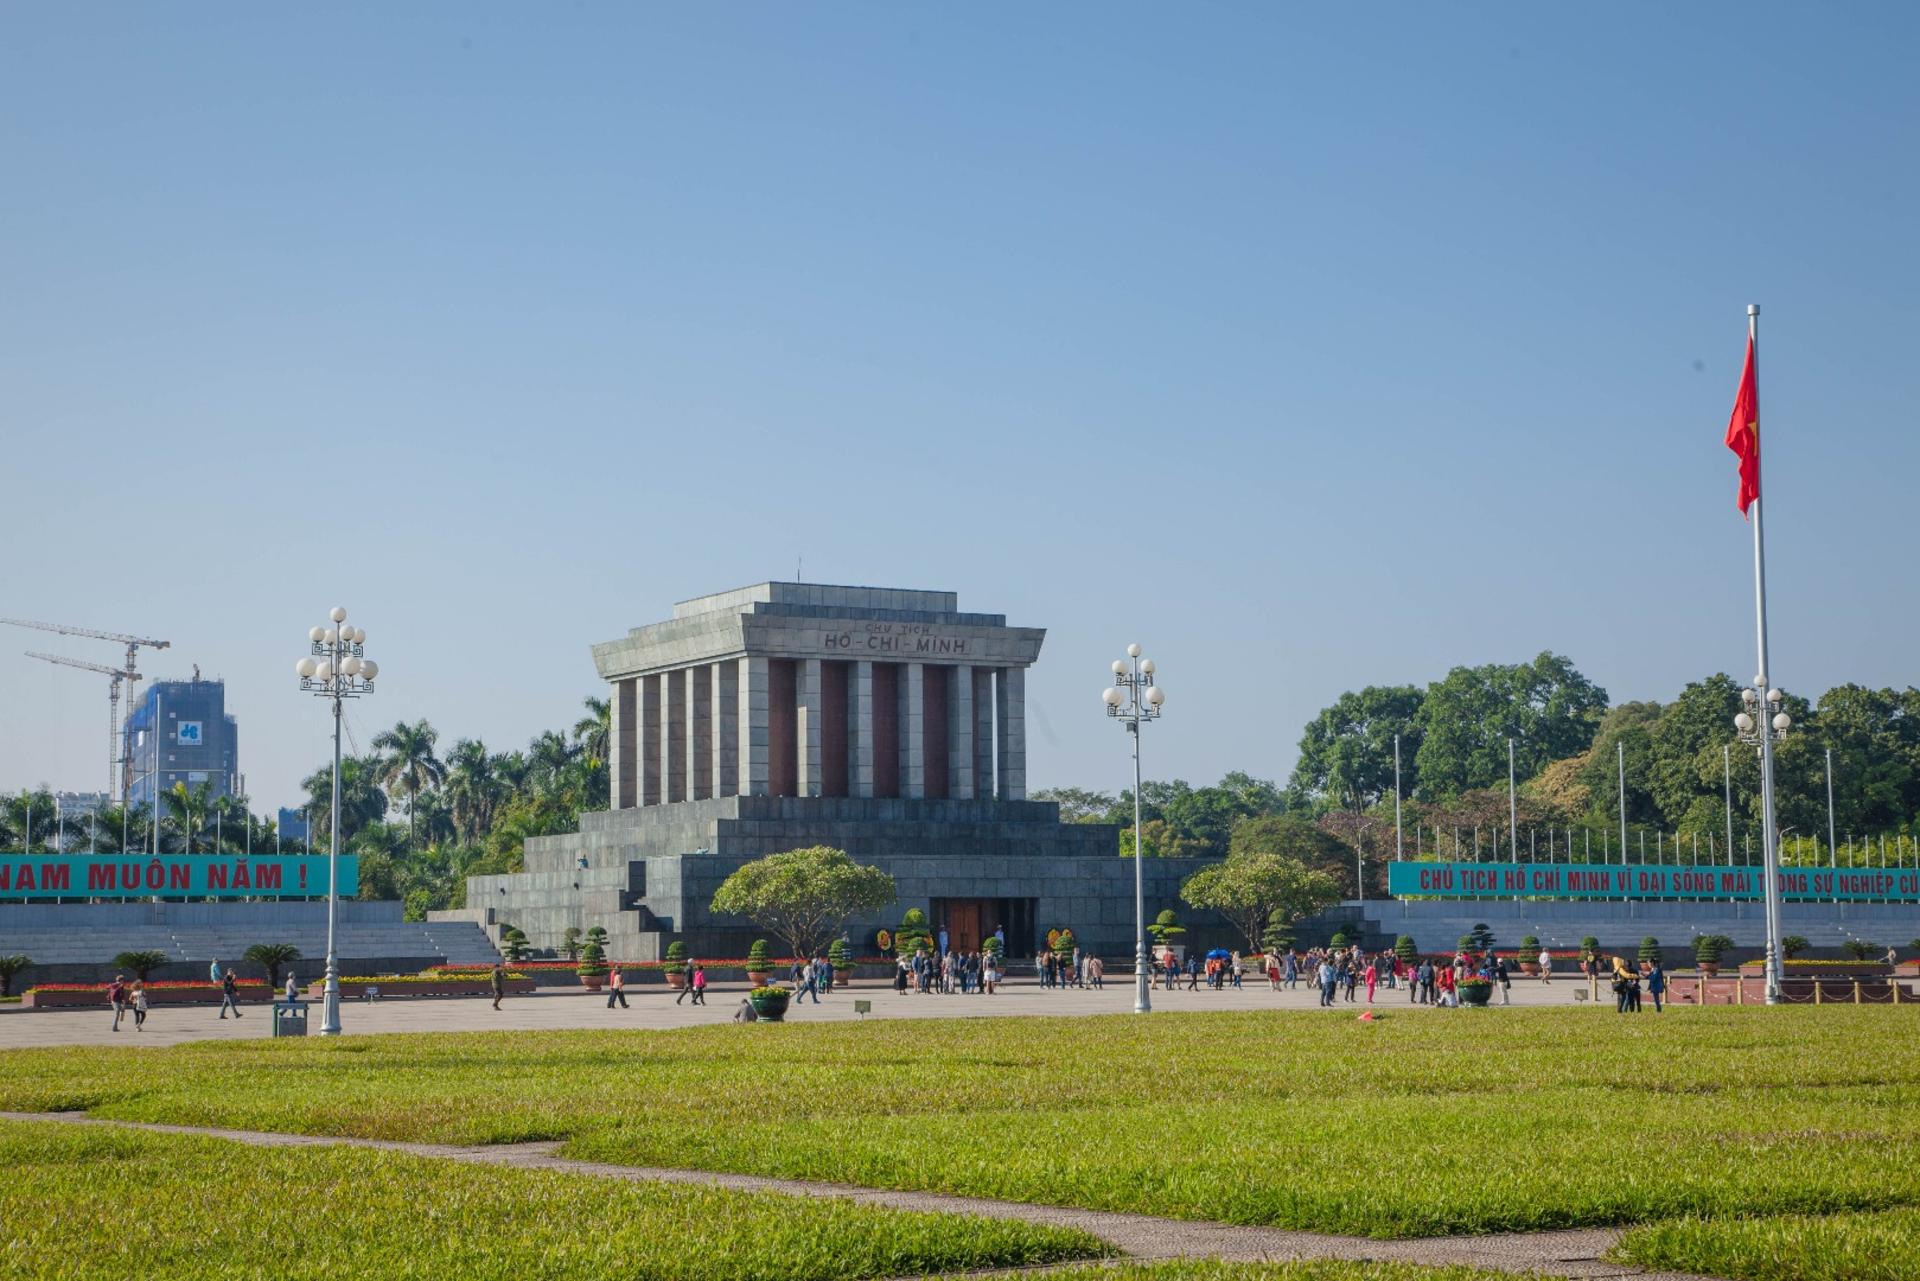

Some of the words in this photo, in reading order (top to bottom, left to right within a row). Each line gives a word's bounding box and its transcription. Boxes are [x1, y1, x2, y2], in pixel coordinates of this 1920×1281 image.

[88, 858, 190, 890] MUÔN
[207, 858, 282, 889] NĂM
[1420, 863, 1453, 890] CHỦ
[1461, 870, 1497, 895] TỊCH
[1533, 867, 1560, 891] CHÍ
[1568, 871, 1610, 891] MINH
[1639, 871, 1666, 896] ĐẠI
[1673, 866, 1714, 892] SỐNG
[1722, 869, 1751, 892] MÃI
[1757, 873, 1807, 893] TONG
[1814, 871, 1834, 896] SỰ
[1840, 871, 1893, 897] NGHIỆP
